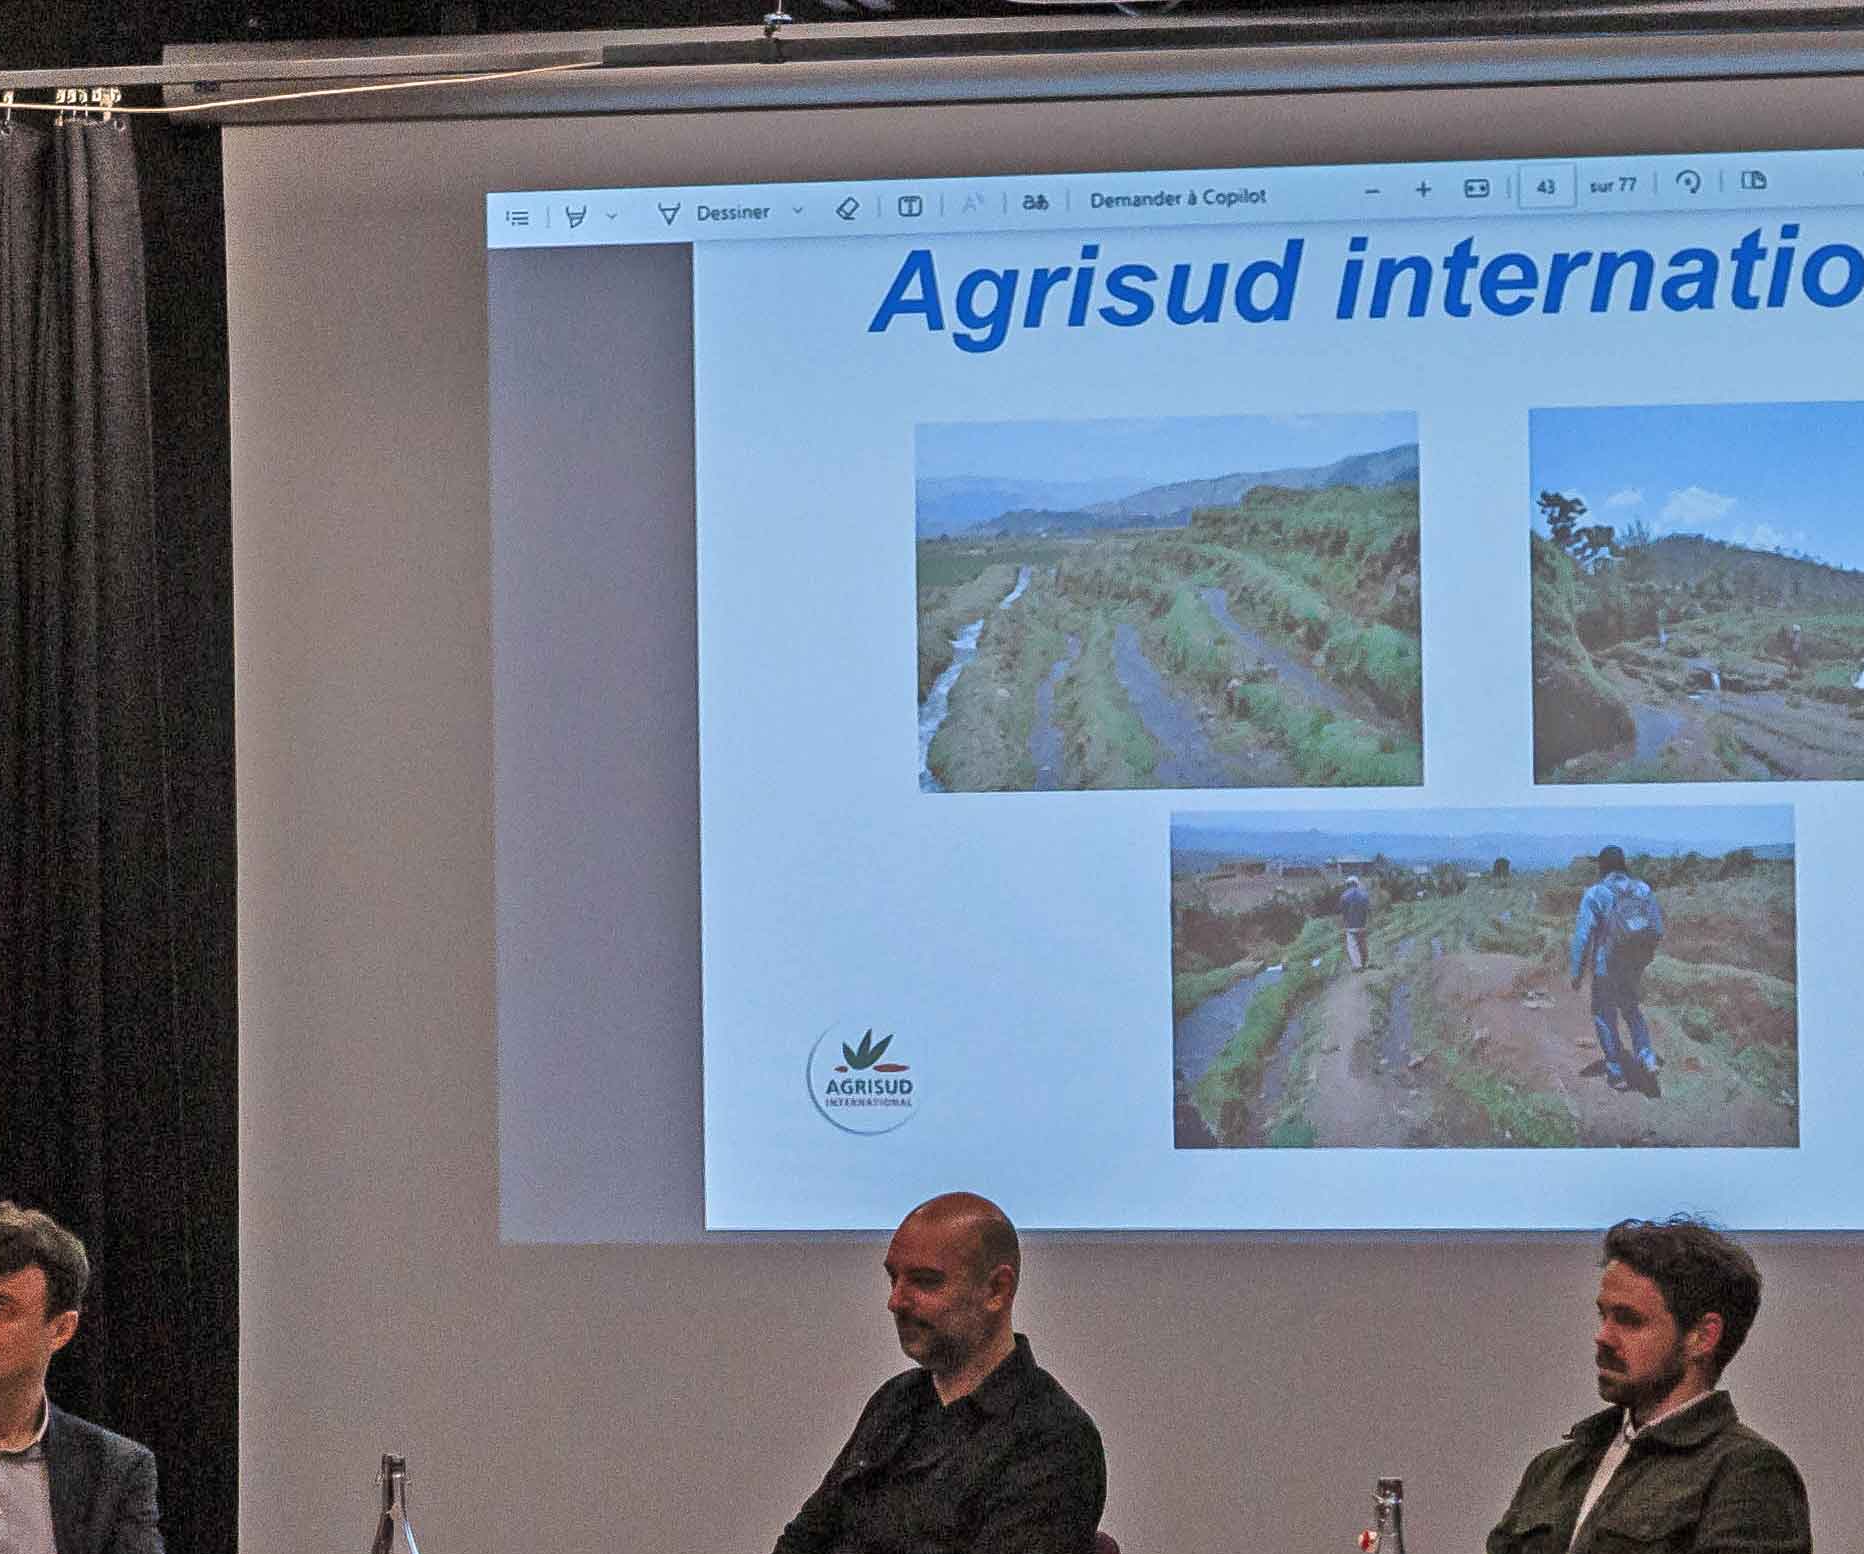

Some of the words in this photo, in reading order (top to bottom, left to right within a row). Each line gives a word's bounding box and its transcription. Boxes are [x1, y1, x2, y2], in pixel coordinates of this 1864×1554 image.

[1537, 178, 1556, 193] 43
[1590, 180, 1613, 192] sur
[1618, 176, 1637, 191] 77
[1090, 189, 1181, 209] Demander
[1188, 188, 1198, 206] à
[1203, 184, 1267, 208] Copilot
[696, 201, 770, 222] Dessiner
[868, 239, 1304, 354] Agrisud
[826, 1078, 913, 1095] AGRISUD
[825, 1097, 913, 1107] INTERNATIONAL
